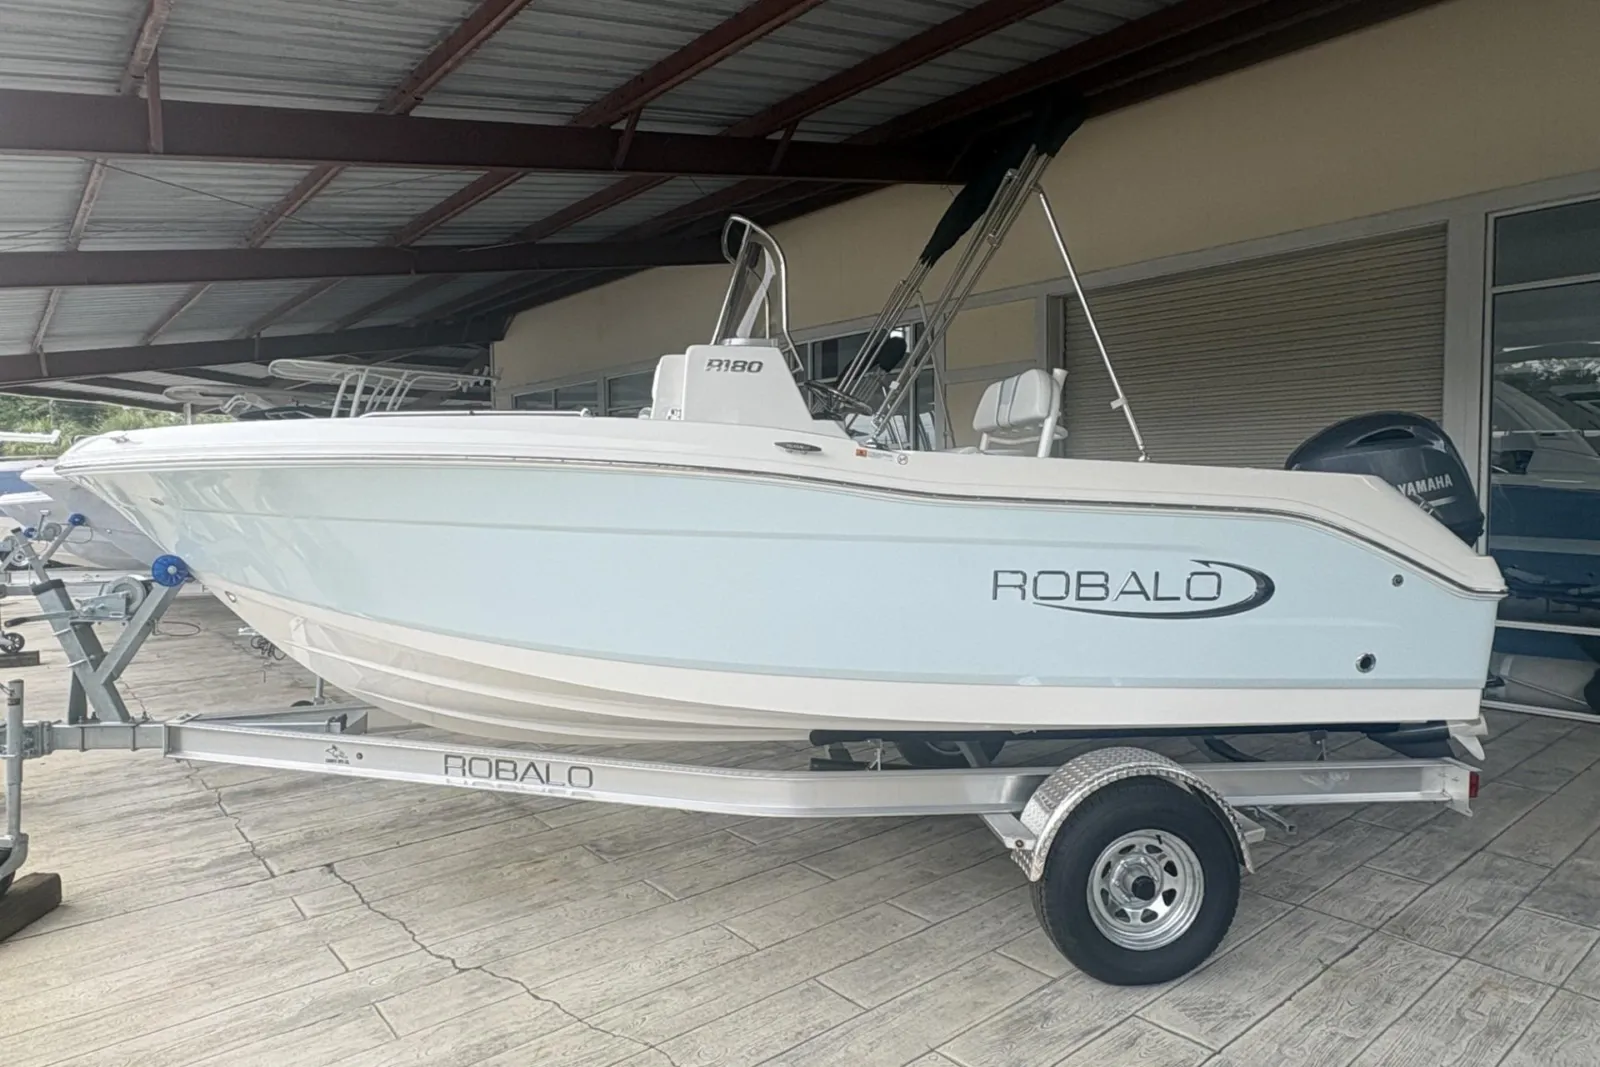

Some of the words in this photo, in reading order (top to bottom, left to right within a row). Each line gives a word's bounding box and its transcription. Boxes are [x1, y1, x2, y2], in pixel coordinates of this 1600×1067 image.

[705, 358, 764, 373] R180
[1397, 473, 1454, 496] YAMAHA
[992, 569, 1222, 601] ROBALO
[444, 754, 594, 788] ROBALO
